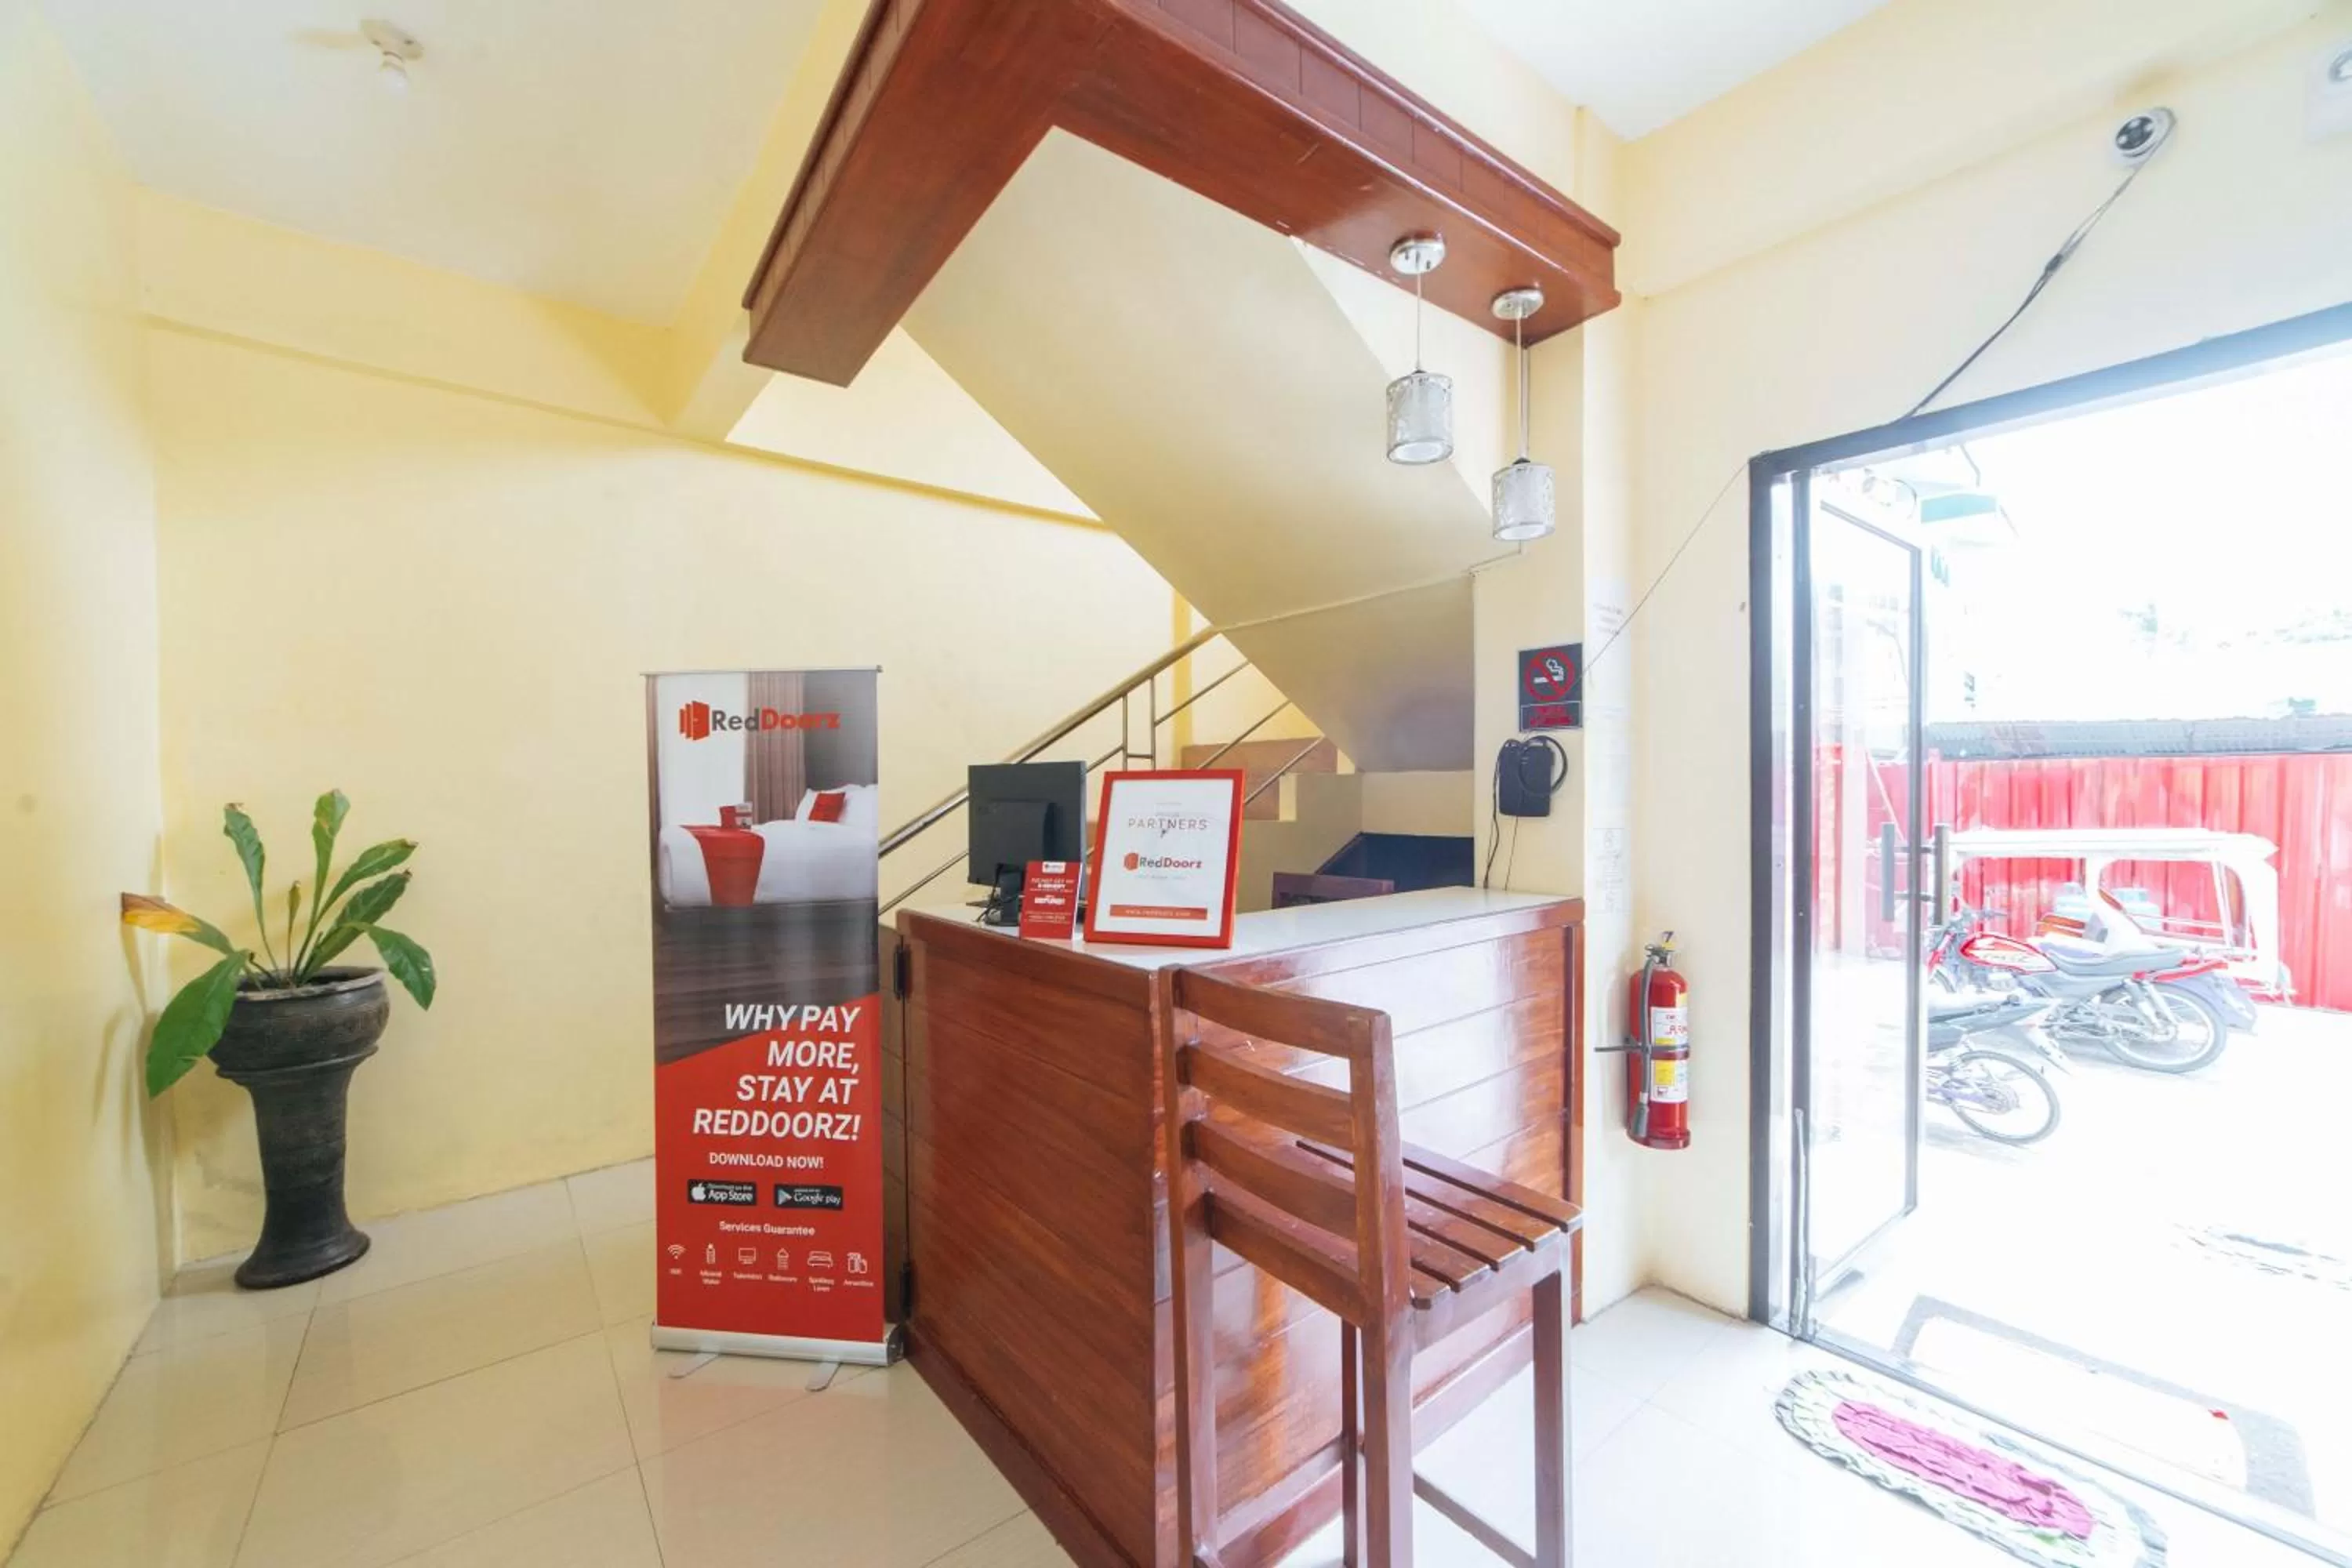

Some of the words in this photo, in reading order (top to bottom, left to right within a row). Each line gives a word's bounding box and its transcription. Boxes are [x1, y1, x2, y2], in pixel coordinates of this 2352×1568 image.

[712, 707, 841, 731] RedDoorz
[1128, 818, 1207, 830] PARTNERS
[1139, 857, 1203, 869] RedDoorz
[724, 1004, 797, 1031] WHY
[799, 1005, 861, 1033] PAY
[767, 1040, 859, 1074] MORE,
[736, 1075, 814, 1103] STAY
[818, 1078, 859, 1105] AT
[693, 1108, 862, 1141] REDDOORZ!
[709, 1152, 784, 1167] DOWNLOAD
[786, 1156, 824, 1169] NOW!
[708, 1190, 728, 1202] App
[728, 1190, 753, 1202] Store
[793, 1192, 824, 1205] Google
[719, 1221, 761, 1233] Services
[764, 1223, 816, 1236] Guarantee
